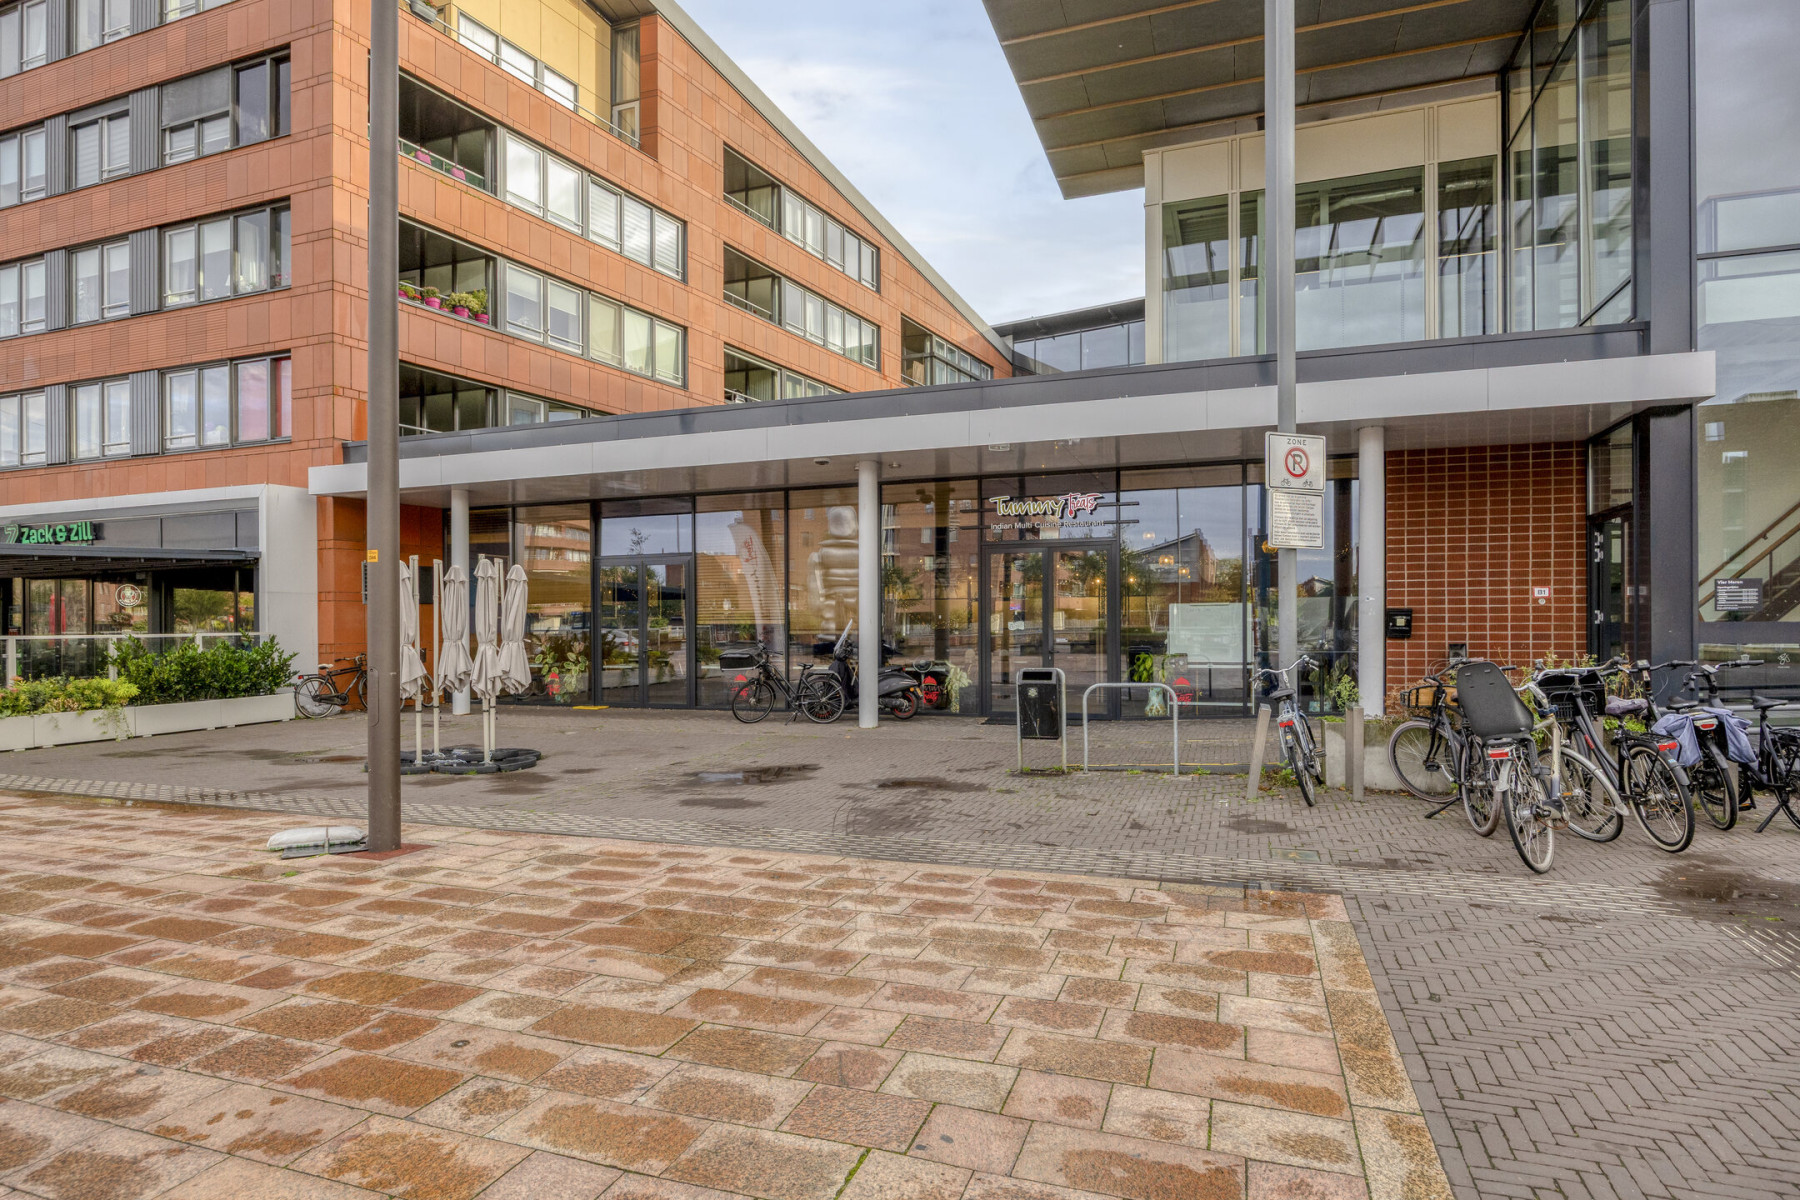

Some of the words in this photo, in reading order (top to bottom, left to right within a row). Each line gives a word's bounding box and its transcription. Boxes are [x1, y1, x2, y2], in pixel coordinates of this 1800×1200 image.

[1287, 438, 1307, 446] ZONE
[989, 496, 1065, 518] Tummy
[1058, 493, 1103, 518] Treats
[1014, 521, 1033, 529] Multi
[1034, 520, 1062, 529] Cuisine
[1064, 519, 1106, 528] Restaurant
[21, 524, 54, 544] Zack
[55, 525, 67, 542] &
[70, 521, 93, 541] Zill
